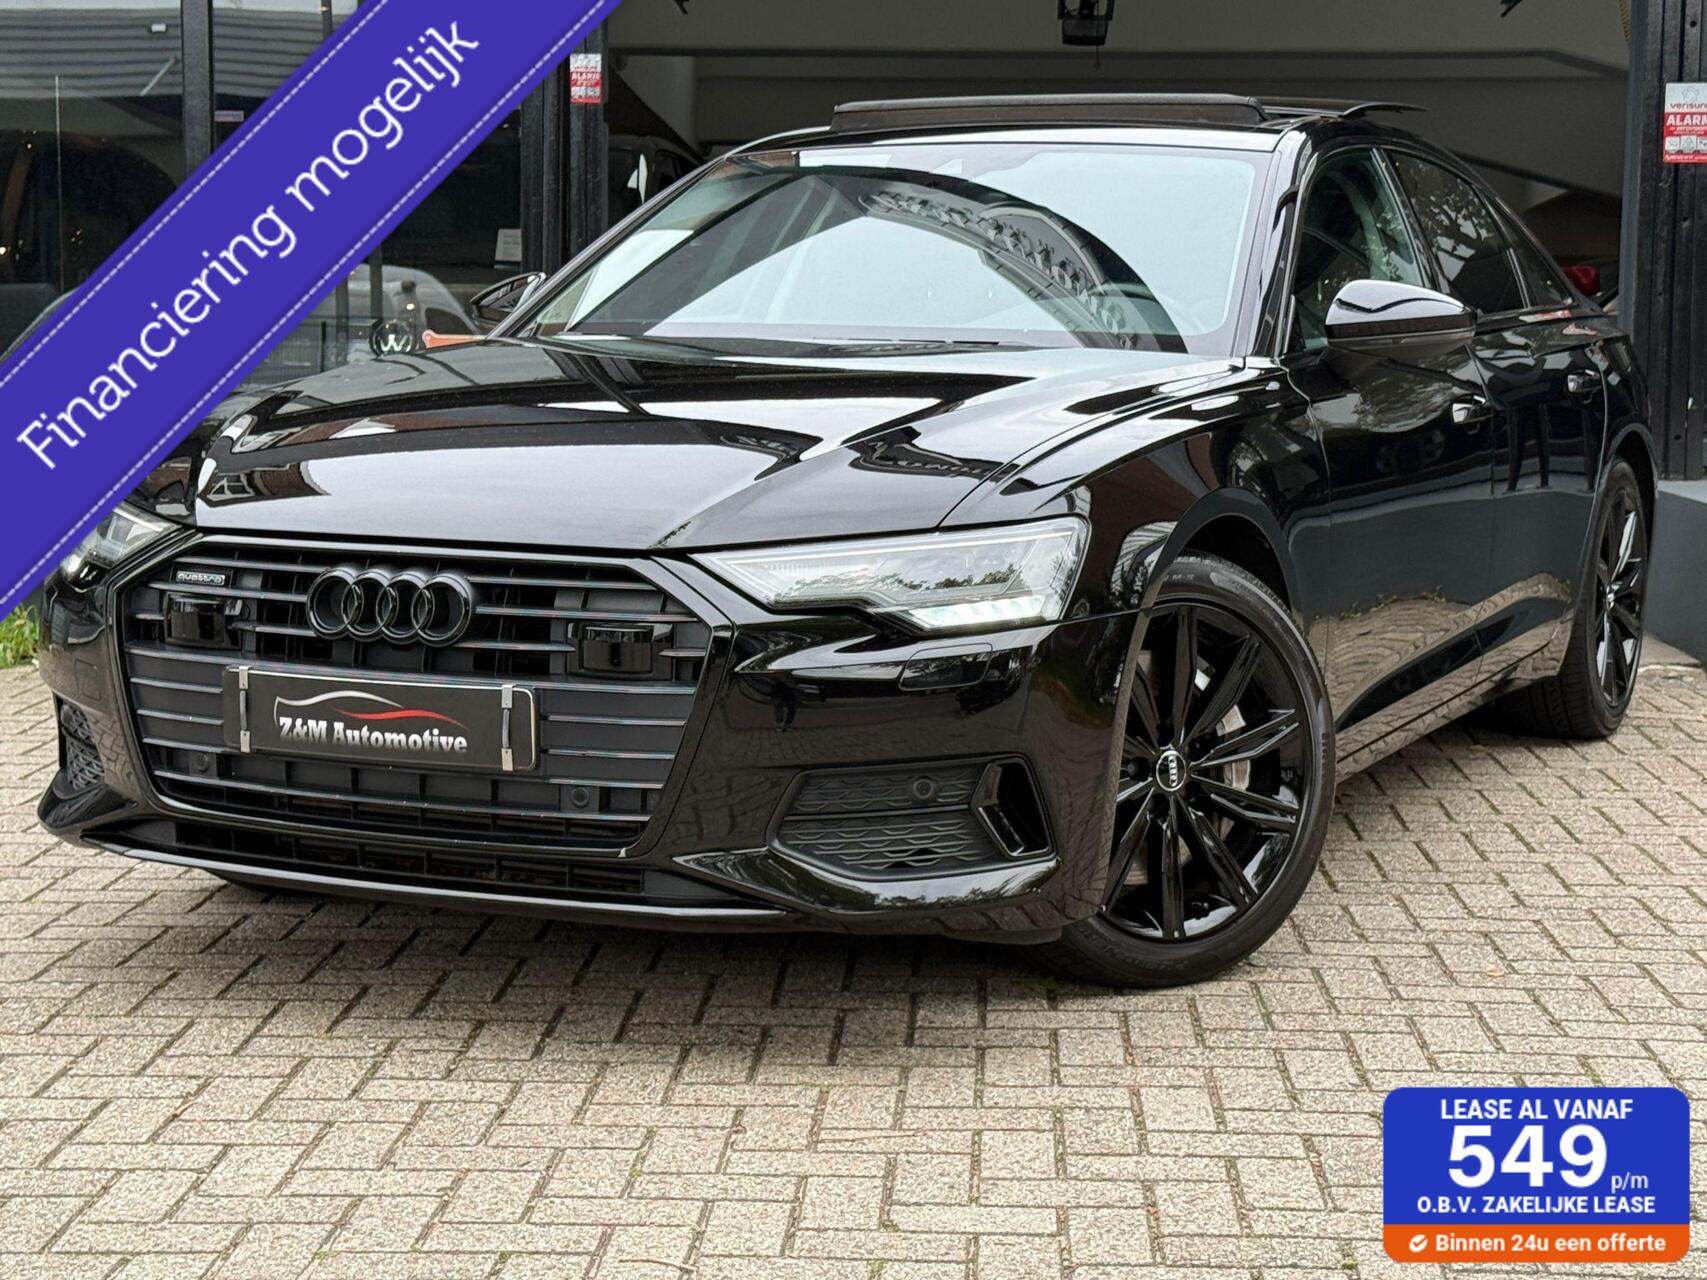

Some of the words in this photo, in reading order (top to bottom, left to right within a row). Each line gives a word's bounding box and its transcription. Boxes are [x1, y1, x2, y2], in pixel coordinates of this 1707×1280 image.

[177, 573, 222, 582] quattro
[279, 716, 328, 743] Z&M
[332, 721, 469, 754] Automotive
